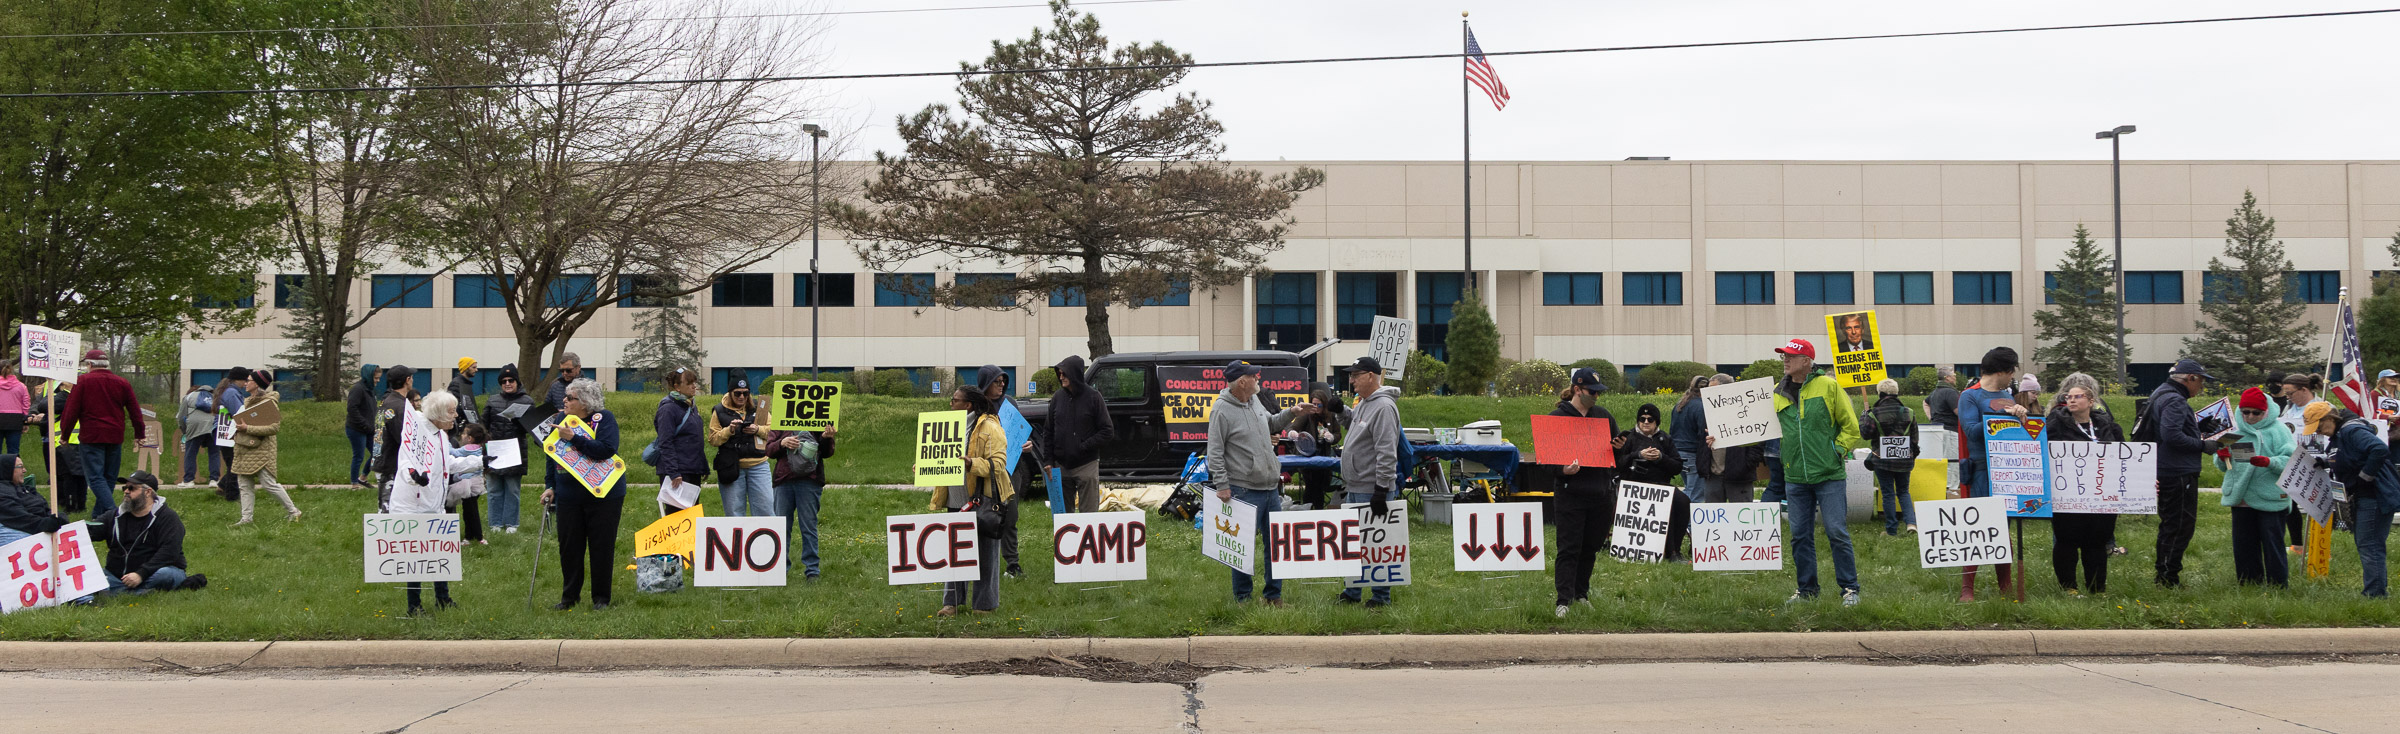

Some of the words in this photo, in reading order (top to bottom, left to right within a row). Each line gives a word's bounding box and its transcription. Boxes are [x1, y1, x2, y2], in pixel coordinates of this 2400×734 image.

[29, 332, 48, 340] DON'T
[1378, 320, 1407, 338] OMG
[1375, 335, 1404, 352] GOP
[1373, 351, 1400, 367] WTF
[1836, 353, 1866, 364] RELEASE
[1867, 351, 1880, 361] THE
[1837, 361, 1883, 374] TRUMP-STEIN
[1262, 380, 1302, 391] CAMPS
[1853, 373, 1871, 383] FILES
[781, 384, 838, 400] STOP
[1161, 395, 1182, 407] ICE
[1186, 395, 1212, 407] OUT
[785, 401, 831, 419] ICE
[1172, 407, 1203, 418] NOW
[1737, 405, 1749, 419] of
[218, 412, 232, 426] IC
[780, 420, 834, 429] EXPANSION
[921, 421, 963, 443] FULL
[1170, 432, 1180, 440] In
[1183, 432, 1208, 440] Romu
[562, 452, 580, 466] NO
[921, 444, 962, 459] RIGHTS
[585, 468, 602, 488] NO
[597, 459, 615, 476] ICE
[919, 466, 962, 476] IMMIGRANTS
[1991, 471, 2014, 480] DEPORT
[2281, 451, 2306, 490] Warehouses
[1623, 484, 1670, 502] TRUMP
[2015, 485, 2043, 494] KRYPTON
[2308, 487, 2319, 504] NOT
[1221, 503, 1233, 516] NO
[1349, 504, 1404, 524] TIME
[1626, 500, 1641, 514] IS
[1647, 503, 1656, 516] A
[1693, 507, 1730, 524] OUR
[1737, 507, 1780, 525] CITY
[1938, 506, 1980, 527] NO
[366, 519, 419, 536] STOP
[426, 519, 460, 535] THE
[1614, 514, 1668, 535] MENACE
[644, 518, 692, 551] CAMPS!!
[1271, 520, 1362, 562] HERE
[1360, 527, 1386, 543] TO
[1628, 532, 1646, 546] TO
[1705, 528, 1721, 542] IS
[1733, 529, 1763, 542] NOT
[1768, 528, 1781, 542] A
[1925, 527, 1999, 547] TRUMP
[376, 539, 460, 555] DETENTION
[705, 526, 782, 573] NO
[889, 522, 978, 573] ICE
[1054, 521, 1147, 566] CAMP
[1215, 533, 1246, 555] KINGS!
[1219, 550, 1243, 569] EVER!!
[1361, 545, 1406, 564] RUSH
[1610, 545, 1663, 563] SOCIETY
[1694, 545, 1729, 563] WAR
[1740, 545, 1781, 561] ZONE
[1925, 545, 2007, 564] GESTAPO
[379, 559, 451, 576] CENTER
[1353, 564, 1405, 584] ICE
[19, 565, 86, 608] OUT
